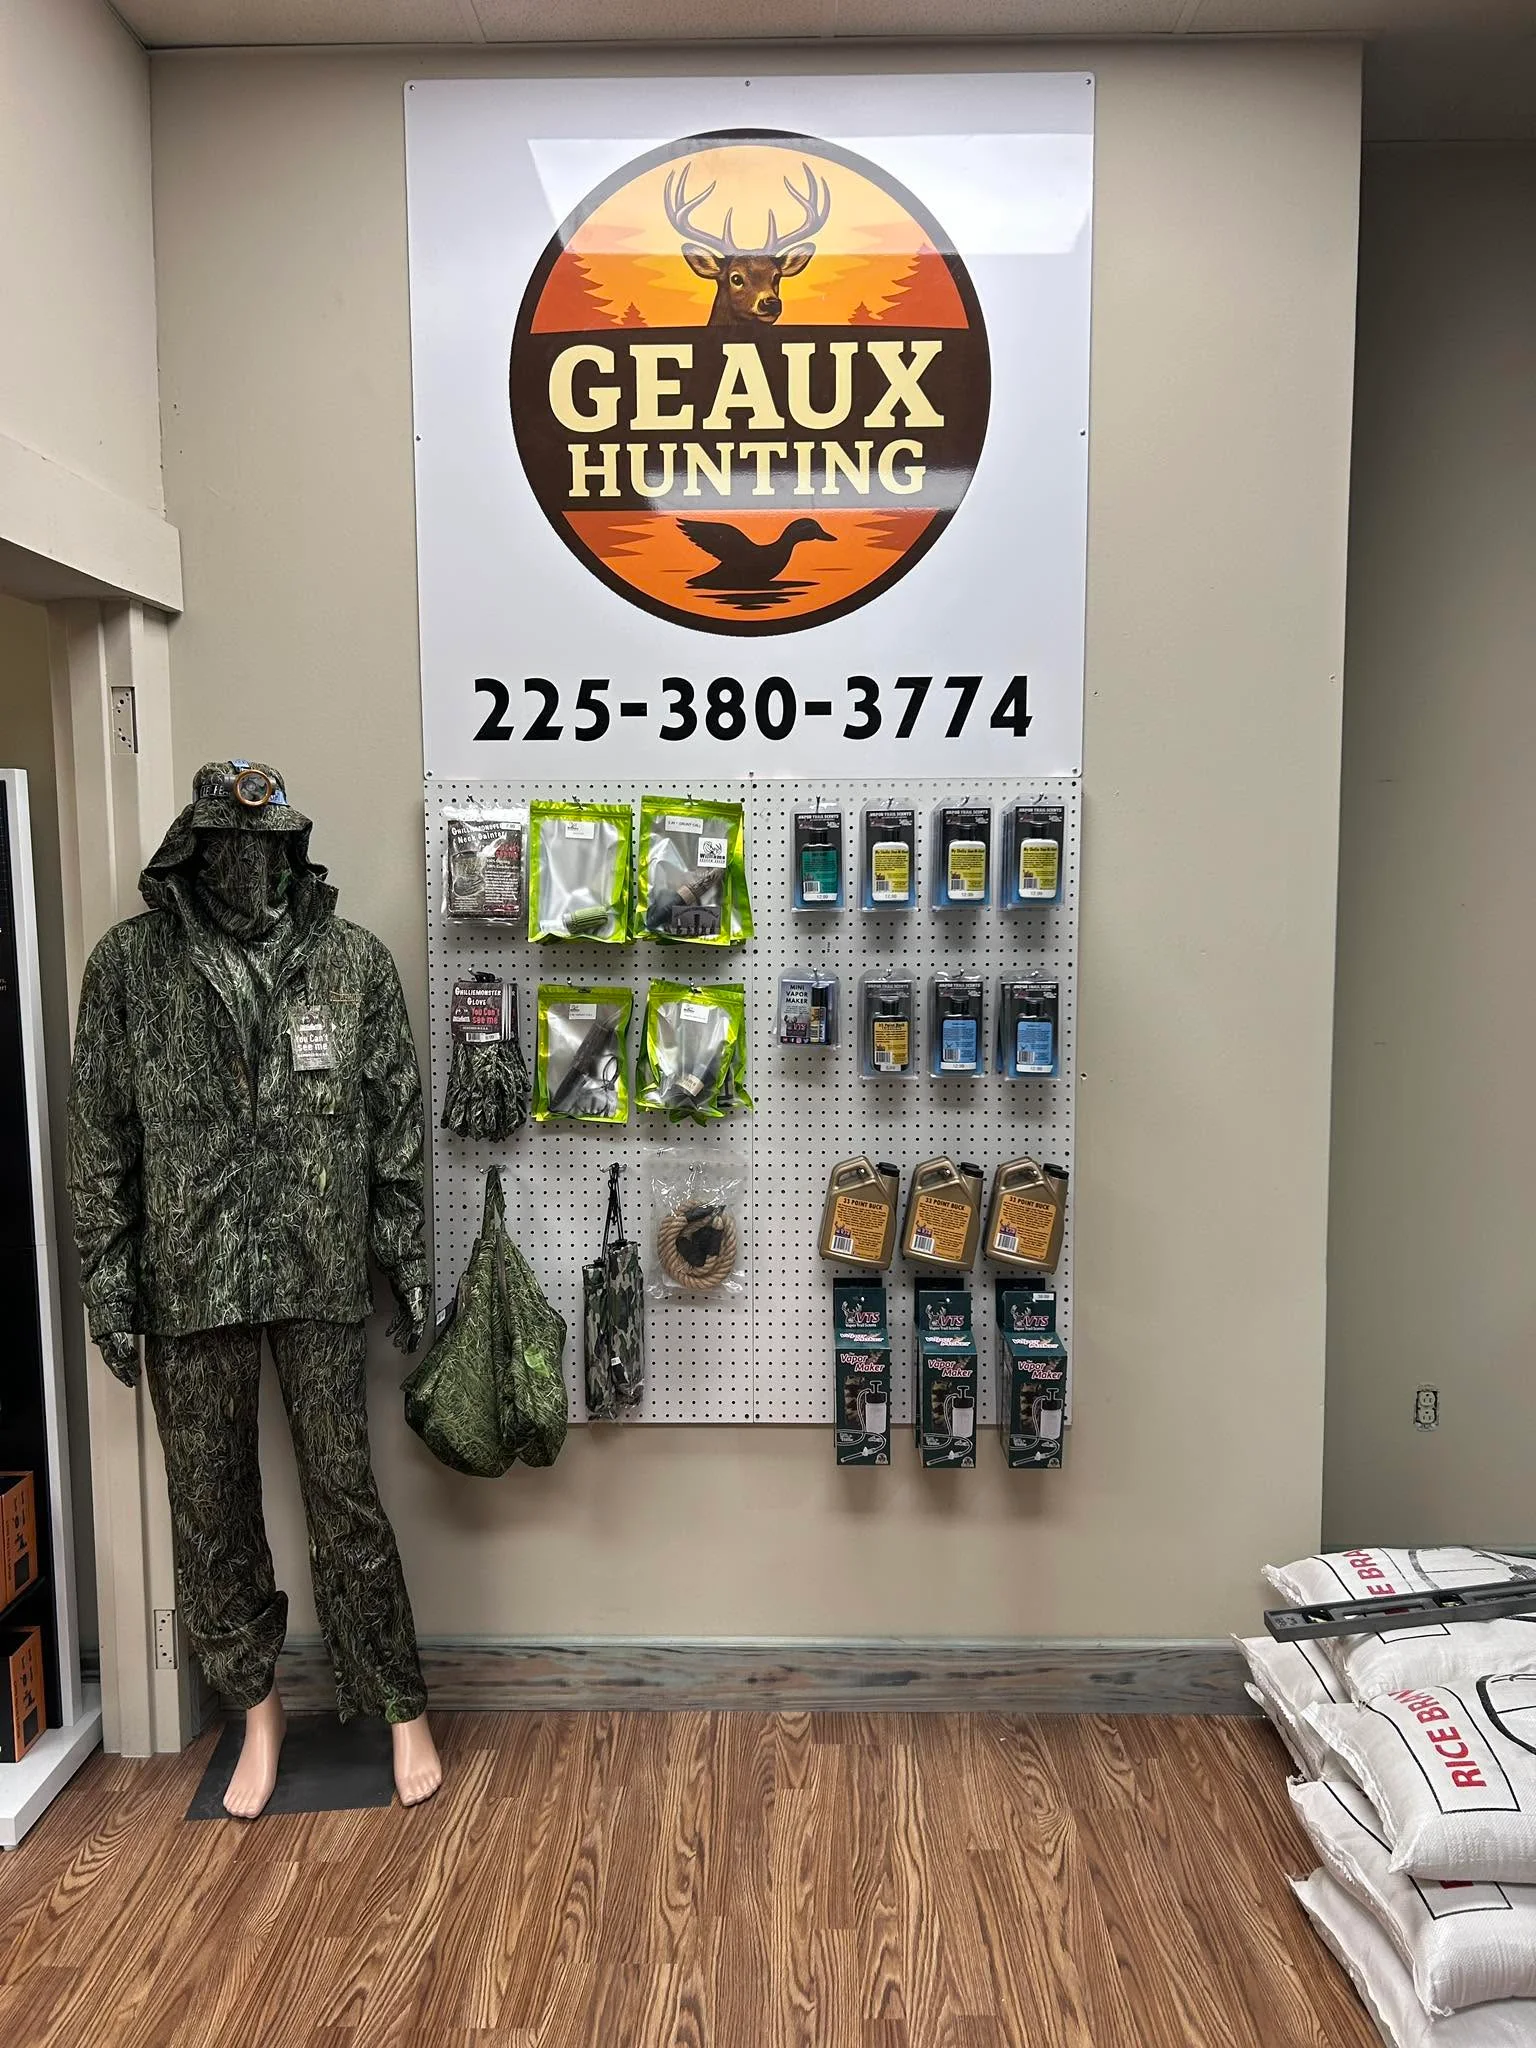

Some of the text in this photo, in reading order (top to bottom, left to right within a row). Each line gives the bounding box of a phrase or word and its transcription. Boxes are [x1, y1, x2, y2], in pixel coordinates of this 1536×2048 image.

[548, 340, 944, 433] GEAUX
[567, 438, 927, 498] HUNTING
[472, 675, 1033, 742] 225-380-3774
[457, 834, 476, 844] Neck
[455, 987, 501, 996] GHILLIEMONSTER
[467, 997, 487, 1005] GLOVE
[296, 1034, 329, 1043] You Can't
[314, 1043, 328, 1051] me
[851, 1200, 868, 1208] POINT
[1017, 1199, 1034, 1207] POINT
[855, 1312, 880, 1324] VTS
[940, 1315, 965, 1326] VTS
[1025, 1316, 1049, 1326] VTS
[840, 1353, 868, 1365] Vapor
[854, 1362, 885, 1372] Maker
[928, 1359, 956, 1370] Vapor
[1018, 1361, 1046, 1372] Vapor
[942, 1368, 973, 1377] Maker
[1032, 1370, 1063, 1379] Maker
[1342, 1549, 1386, 1580] BRA
[1387, 1688, 1487, 1788] RICE BRAN
